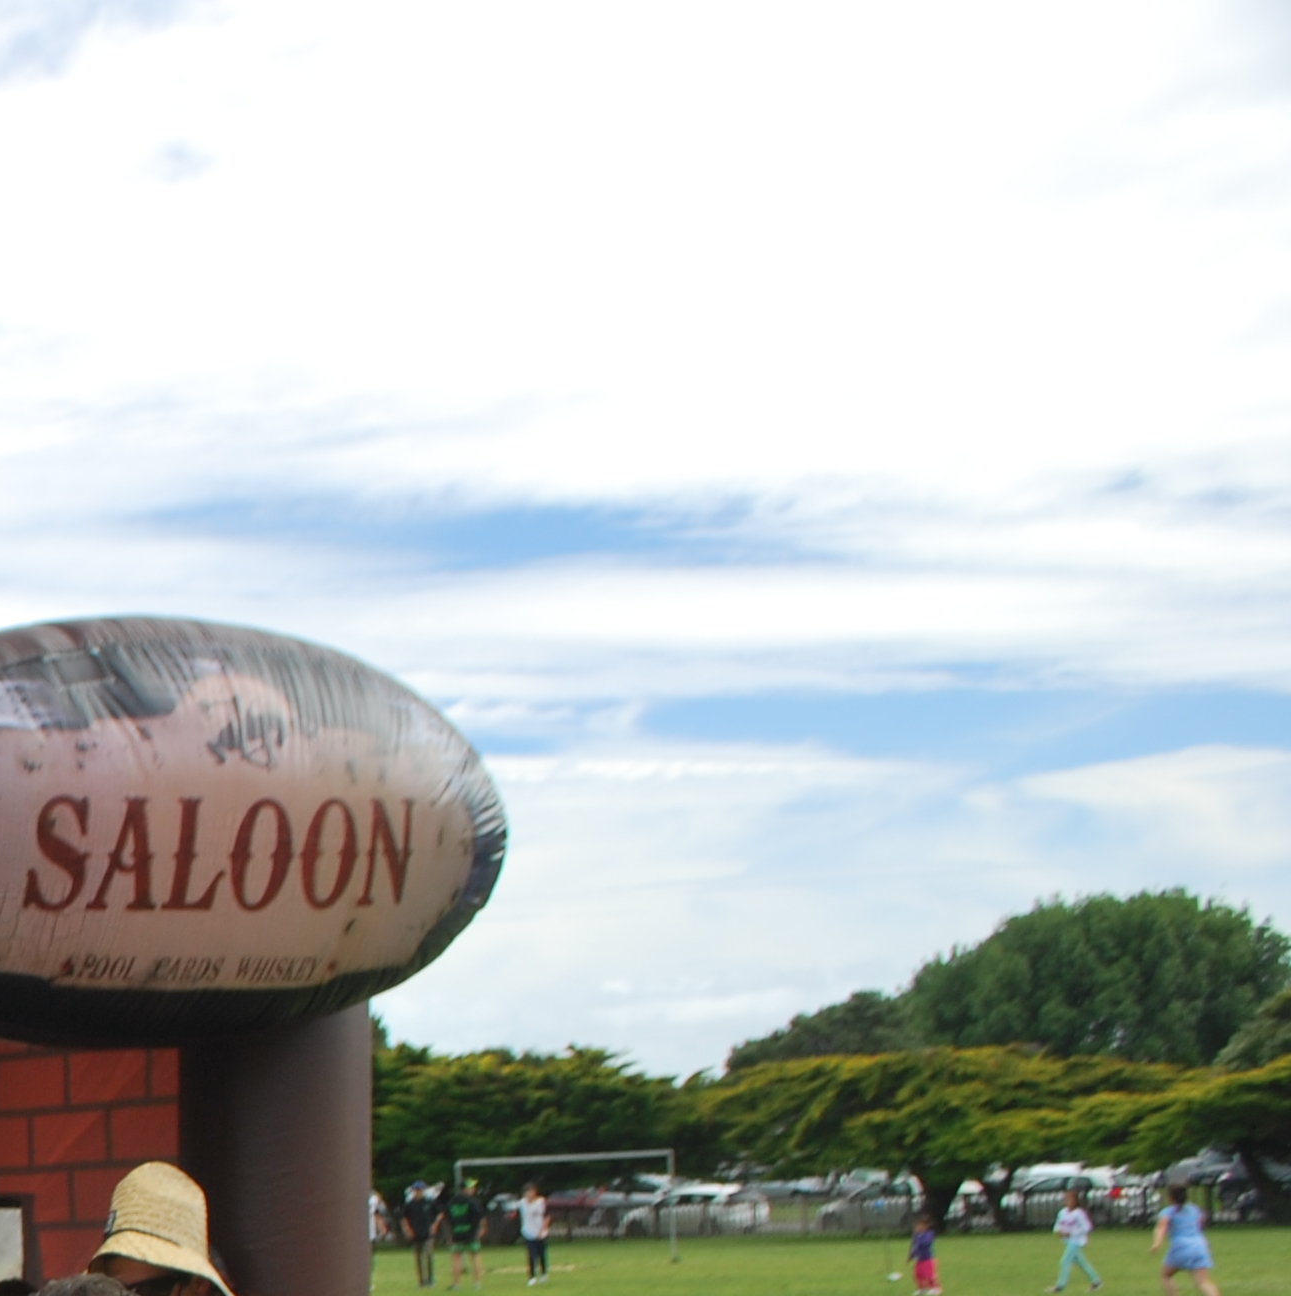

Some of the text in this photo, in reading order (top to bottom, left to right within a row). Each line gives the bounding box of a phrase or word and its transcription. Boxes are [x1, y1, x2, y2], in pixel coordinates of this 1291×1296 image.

[23, 795, 415, 913] SALOON
[78, 953, 322, 983] POOL CARDS WHISKEY
